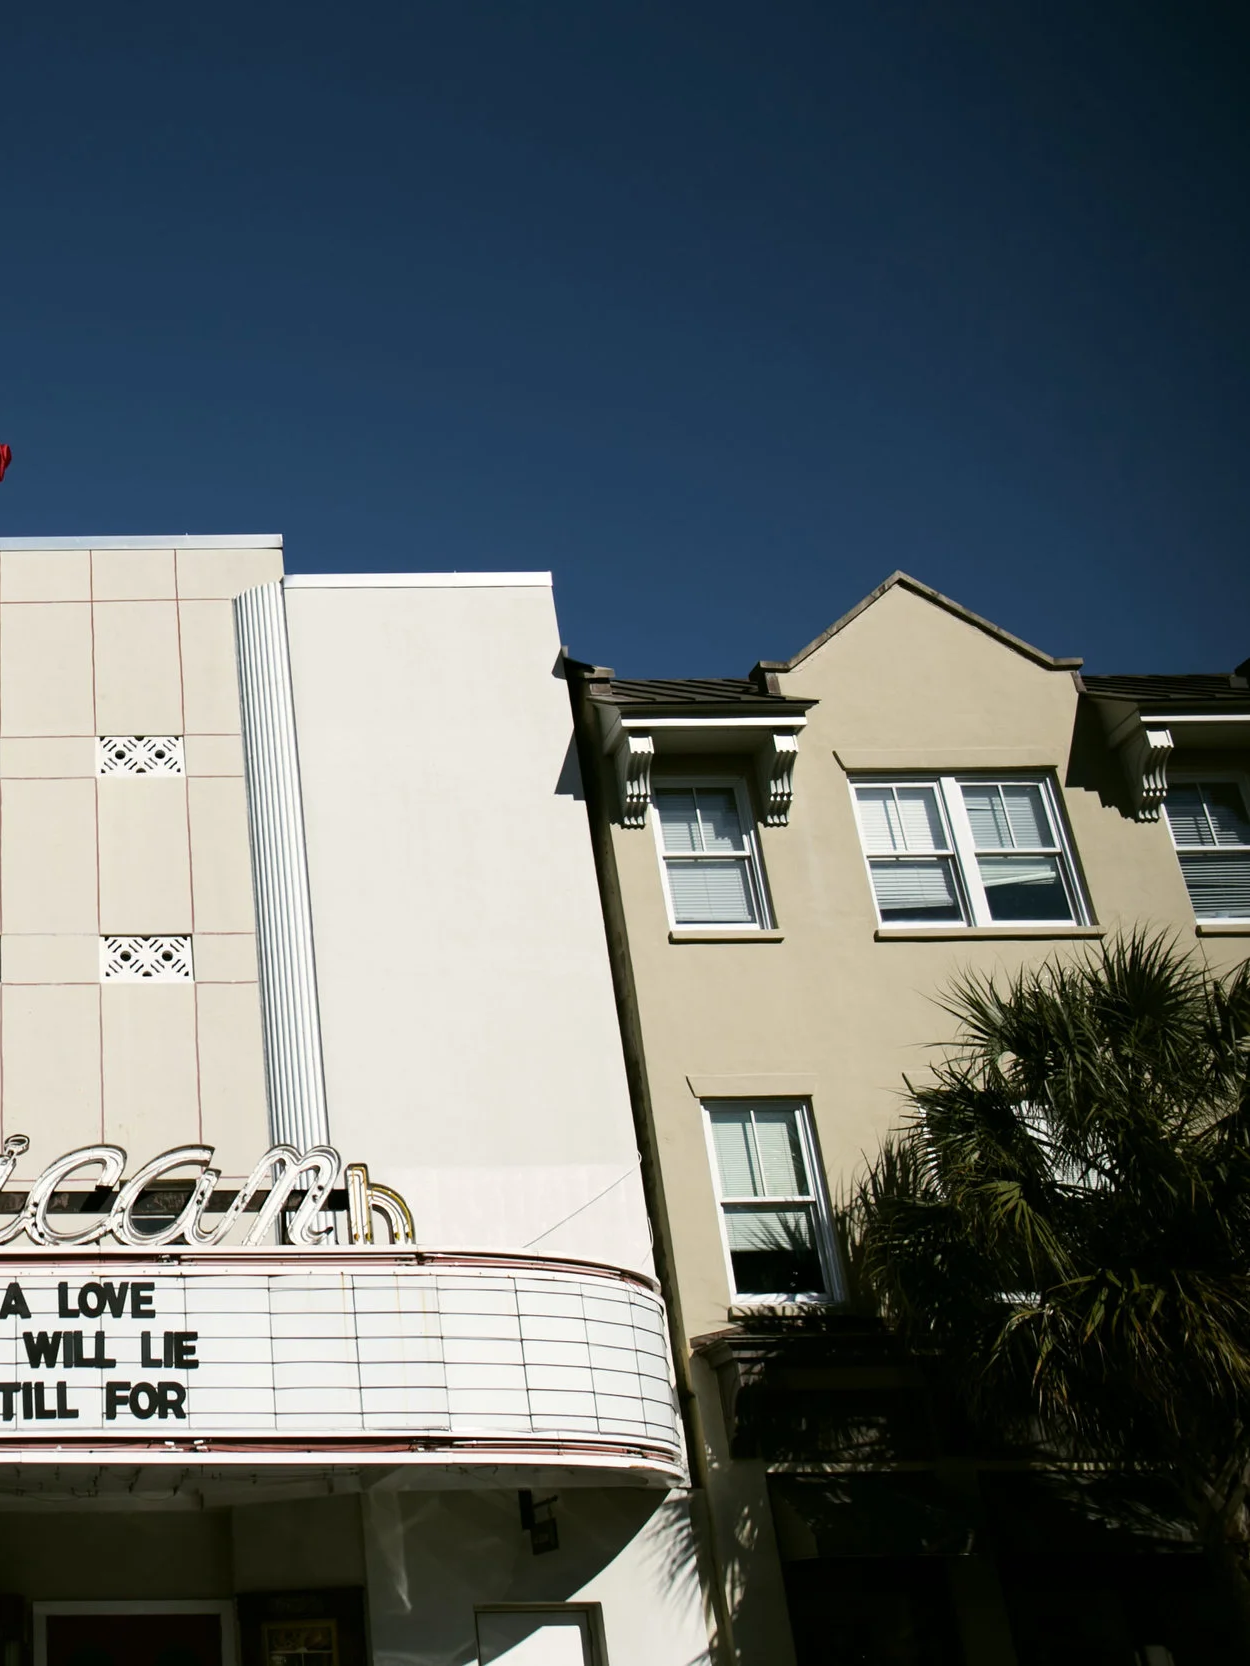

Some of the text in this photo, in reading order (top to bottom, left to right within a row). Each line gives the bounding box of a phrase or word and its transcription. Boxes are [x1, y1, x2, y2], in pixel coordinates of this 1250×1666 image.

[0, 1284, 33, 1320] A
[59, 1283, 156, 1320] LOVE
[23, 1332, 117, 1369] WILL
[142, 1332, 200, 1370] LIE
[106, 1383, 188, 1420] FOR
